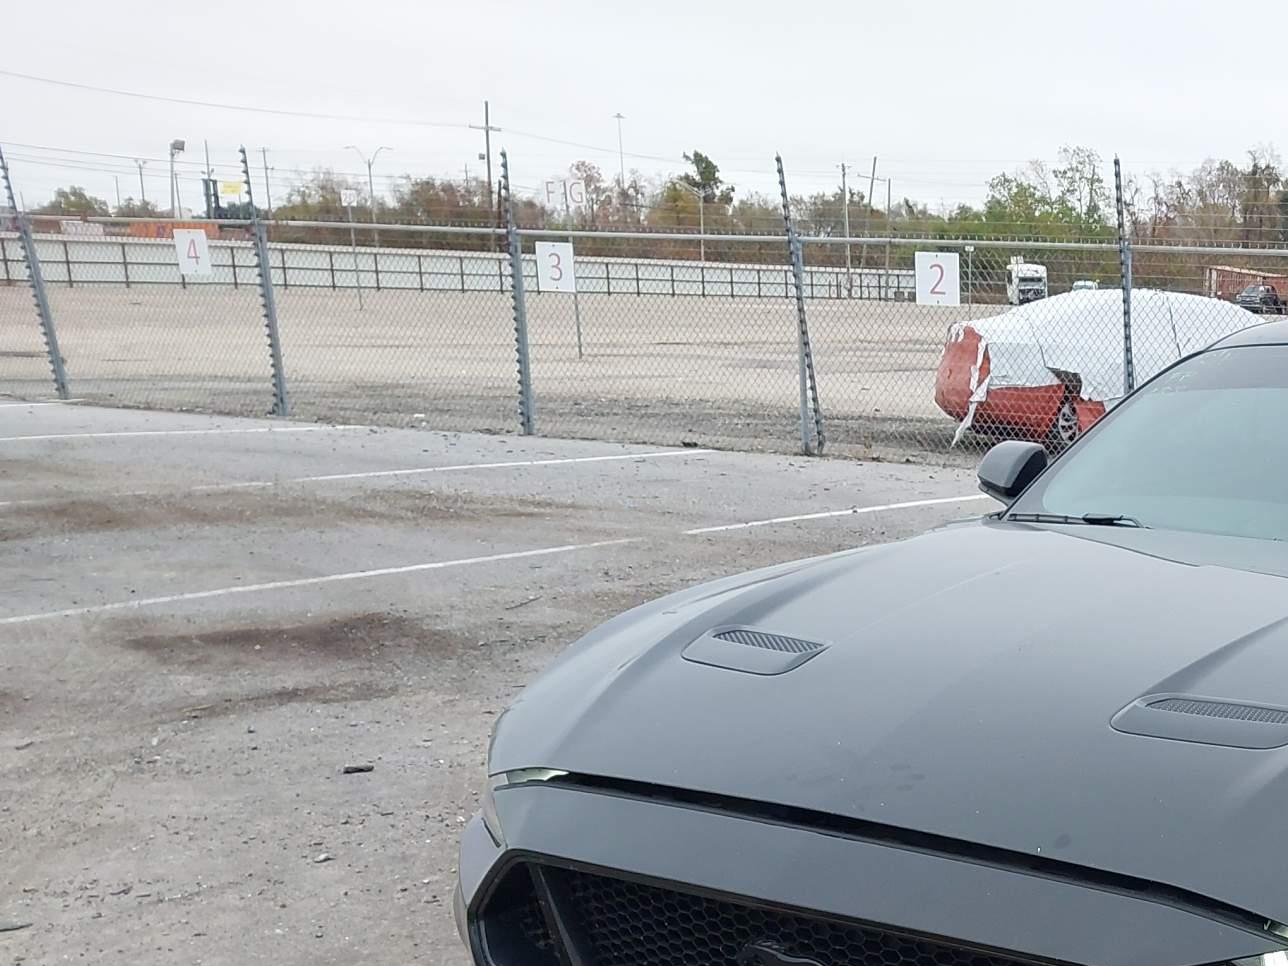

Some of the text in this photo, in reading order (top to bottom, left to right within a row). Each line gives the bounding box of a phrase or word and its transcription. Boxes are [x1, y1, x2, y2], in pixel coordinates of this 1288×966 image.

[545, 181, 555, 204] F
[569, 181, 583, 204] G
[187, 239, 201, 266] 4
[548, 253, 563, 282] 3
[929, 263, 947, 295] 2
